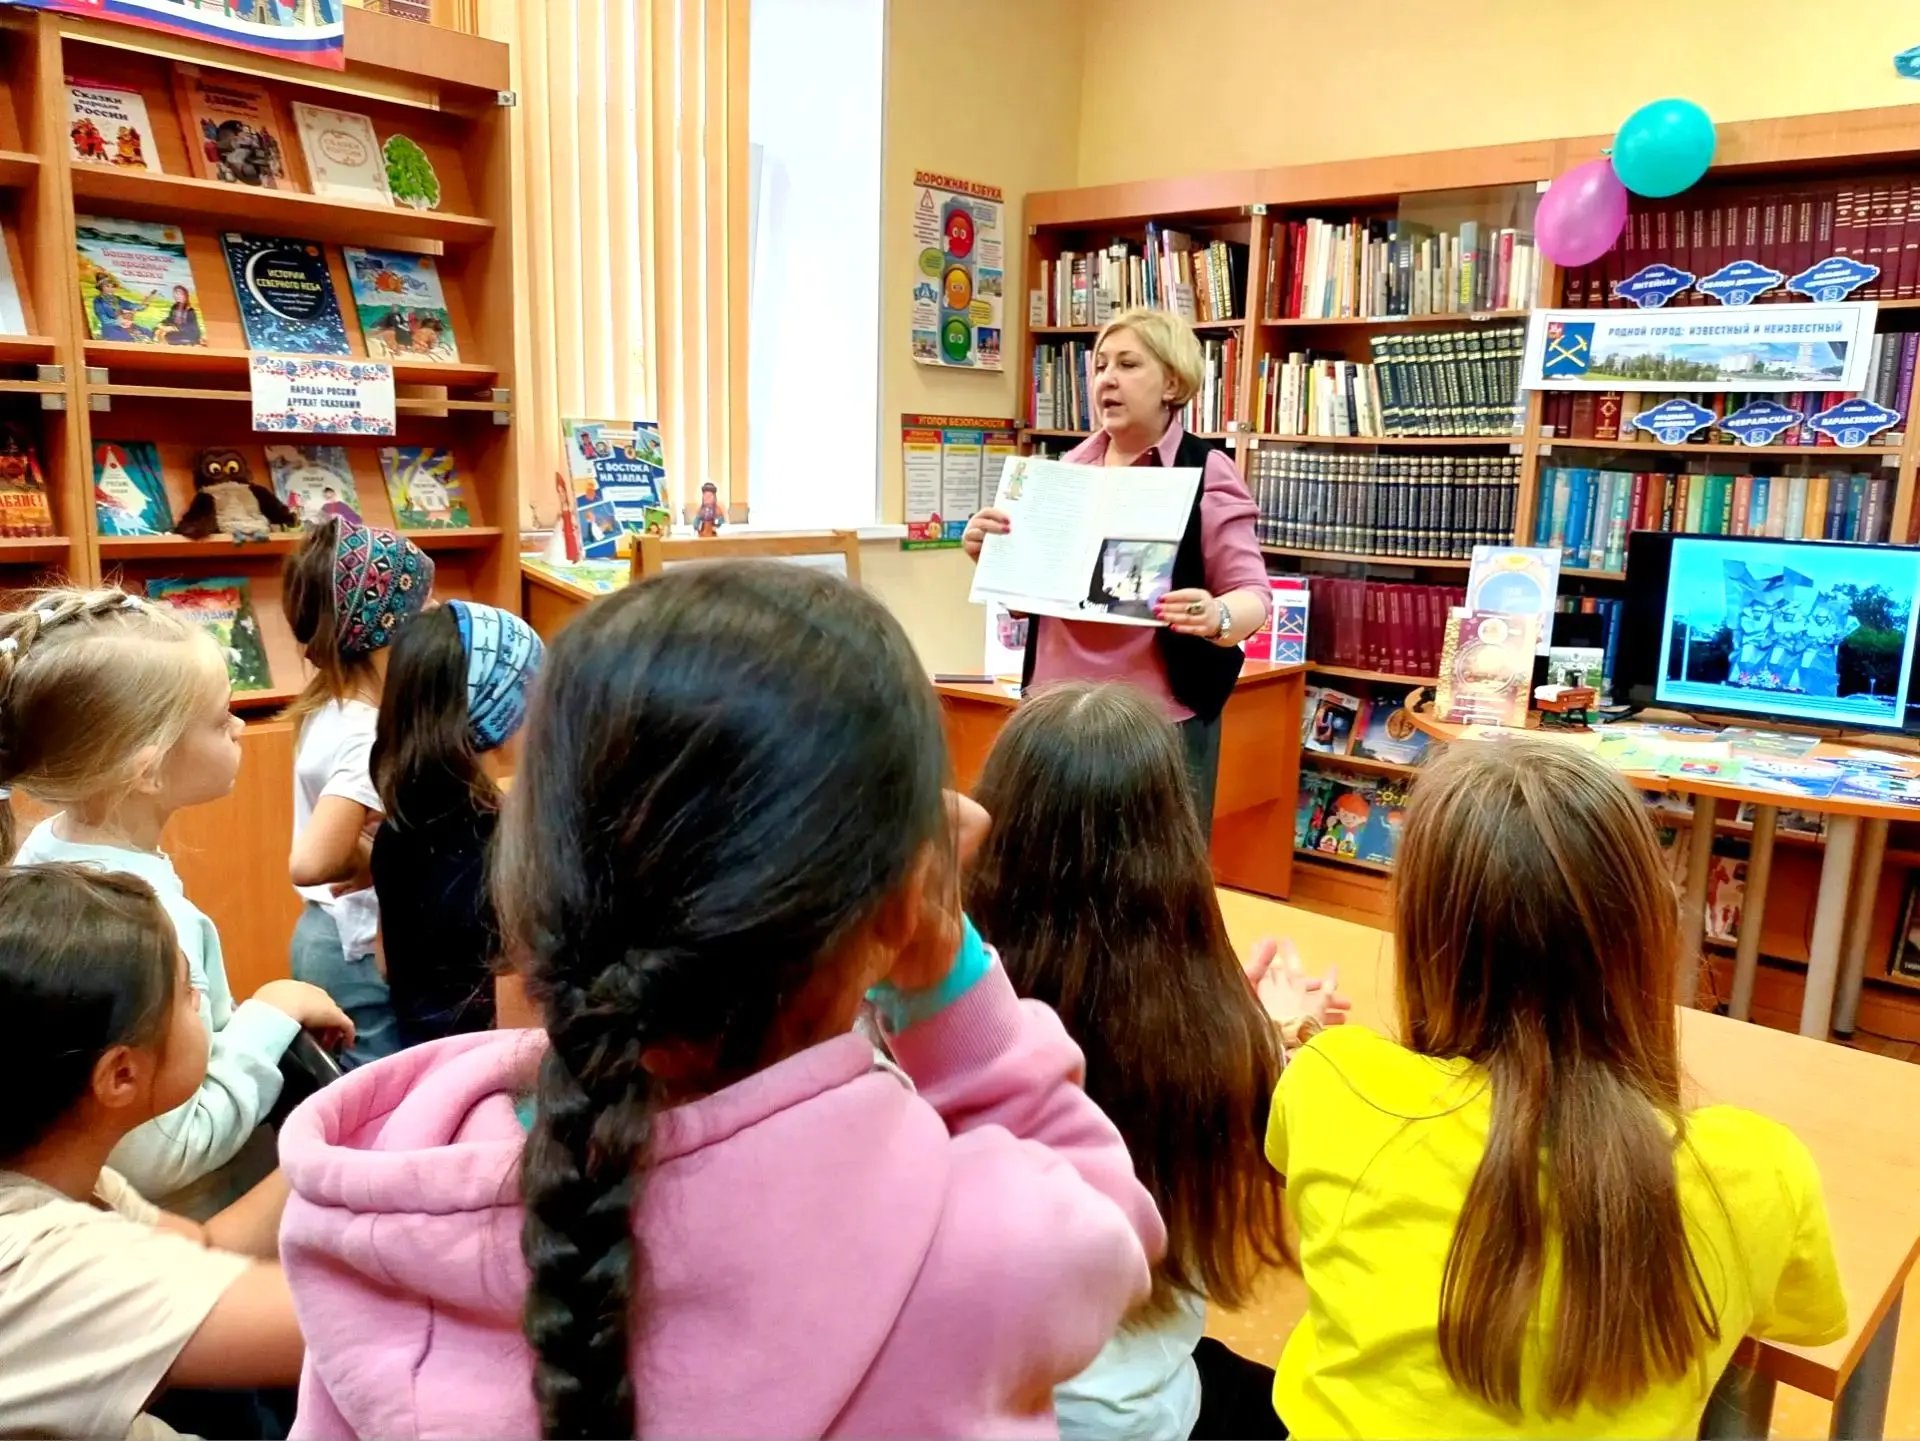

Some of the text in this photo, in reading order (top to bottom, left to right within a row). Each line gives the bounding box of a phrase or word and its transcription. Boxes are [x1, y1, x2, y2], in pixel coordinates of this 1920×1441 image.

[71, 89, 122, 104] Сказки
[74, 103, 129, 120] России
[915, 171, 1002, 199] ДОРОЖНАЯ АЗБУКА
[267, 269, 306, 280] ИСТОРИИ
[256, 278, 322, 292] СЕВЕРНОГО НЕБА
[1631, 277, 1678, 291] ЛИТЕЙНАЯ
[1608, 320, 1843, 337] РОДНОЙ ГОРОД: ИЗВЕСТНЫЙ И НЕИЗВЕСТНЫЙ
[290, 385, 357, 397] НАРОДЫ РОССИИ
[287, 397, 361, 409] ДРУЖАТ СКАЗКАМИ
[918, 416, 1006, 429] УГОЛОК БЕЗОПАСНОСТИ
[1727, 415, 1793, 427] ФЕВРАЛЬСКАЯ
[605, 462, 650, 473] ВОСТОКА
[600, 473, 649, 483] НА ЗАПАД
